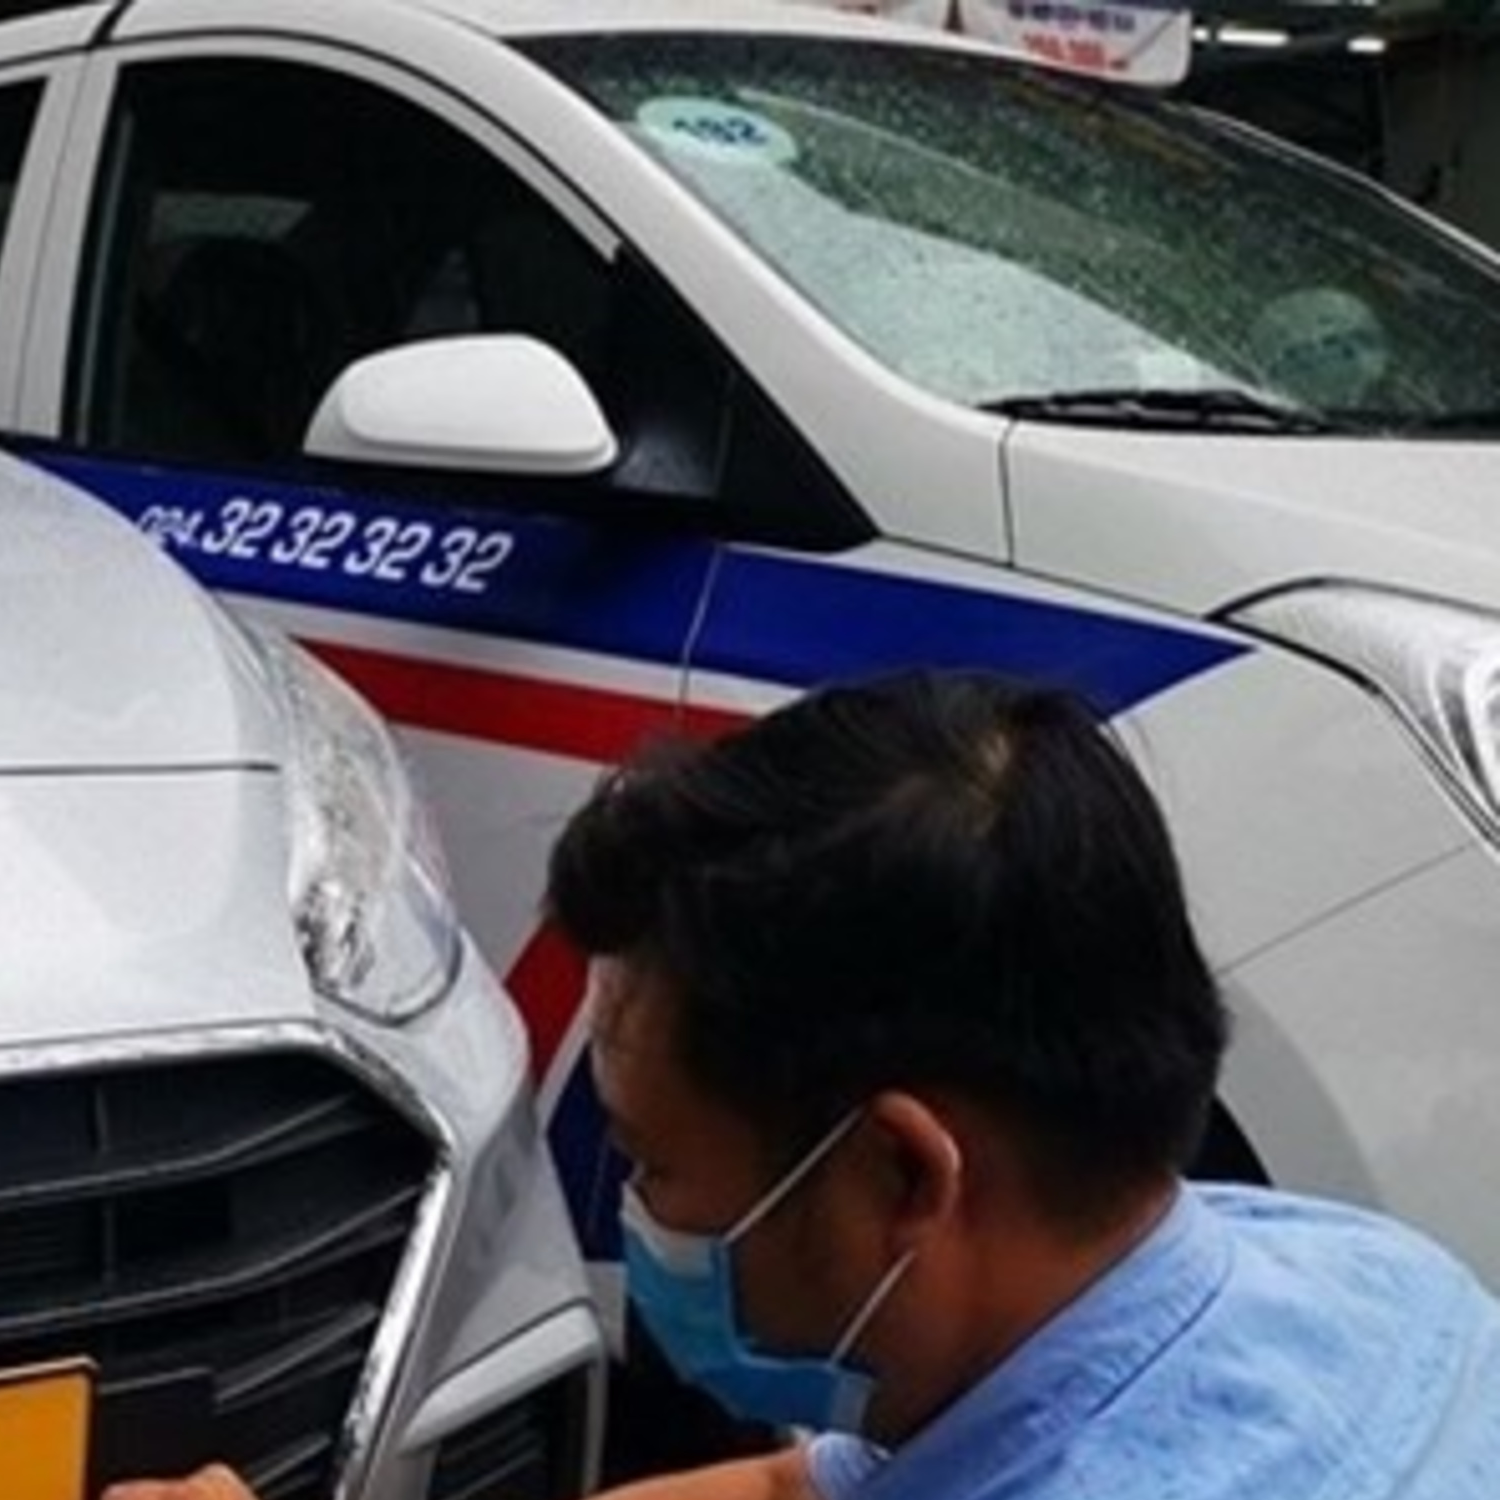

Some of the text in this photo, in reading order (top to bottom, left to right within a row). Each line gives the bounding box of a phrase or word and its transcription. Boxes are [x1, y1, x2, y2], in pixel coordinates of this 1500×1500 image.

[202, 499, 282, 558] 32
[271, 509, 352, 567] 32
[344, 522, 431, 579] 32
[421, 532, 512, 591] 32
